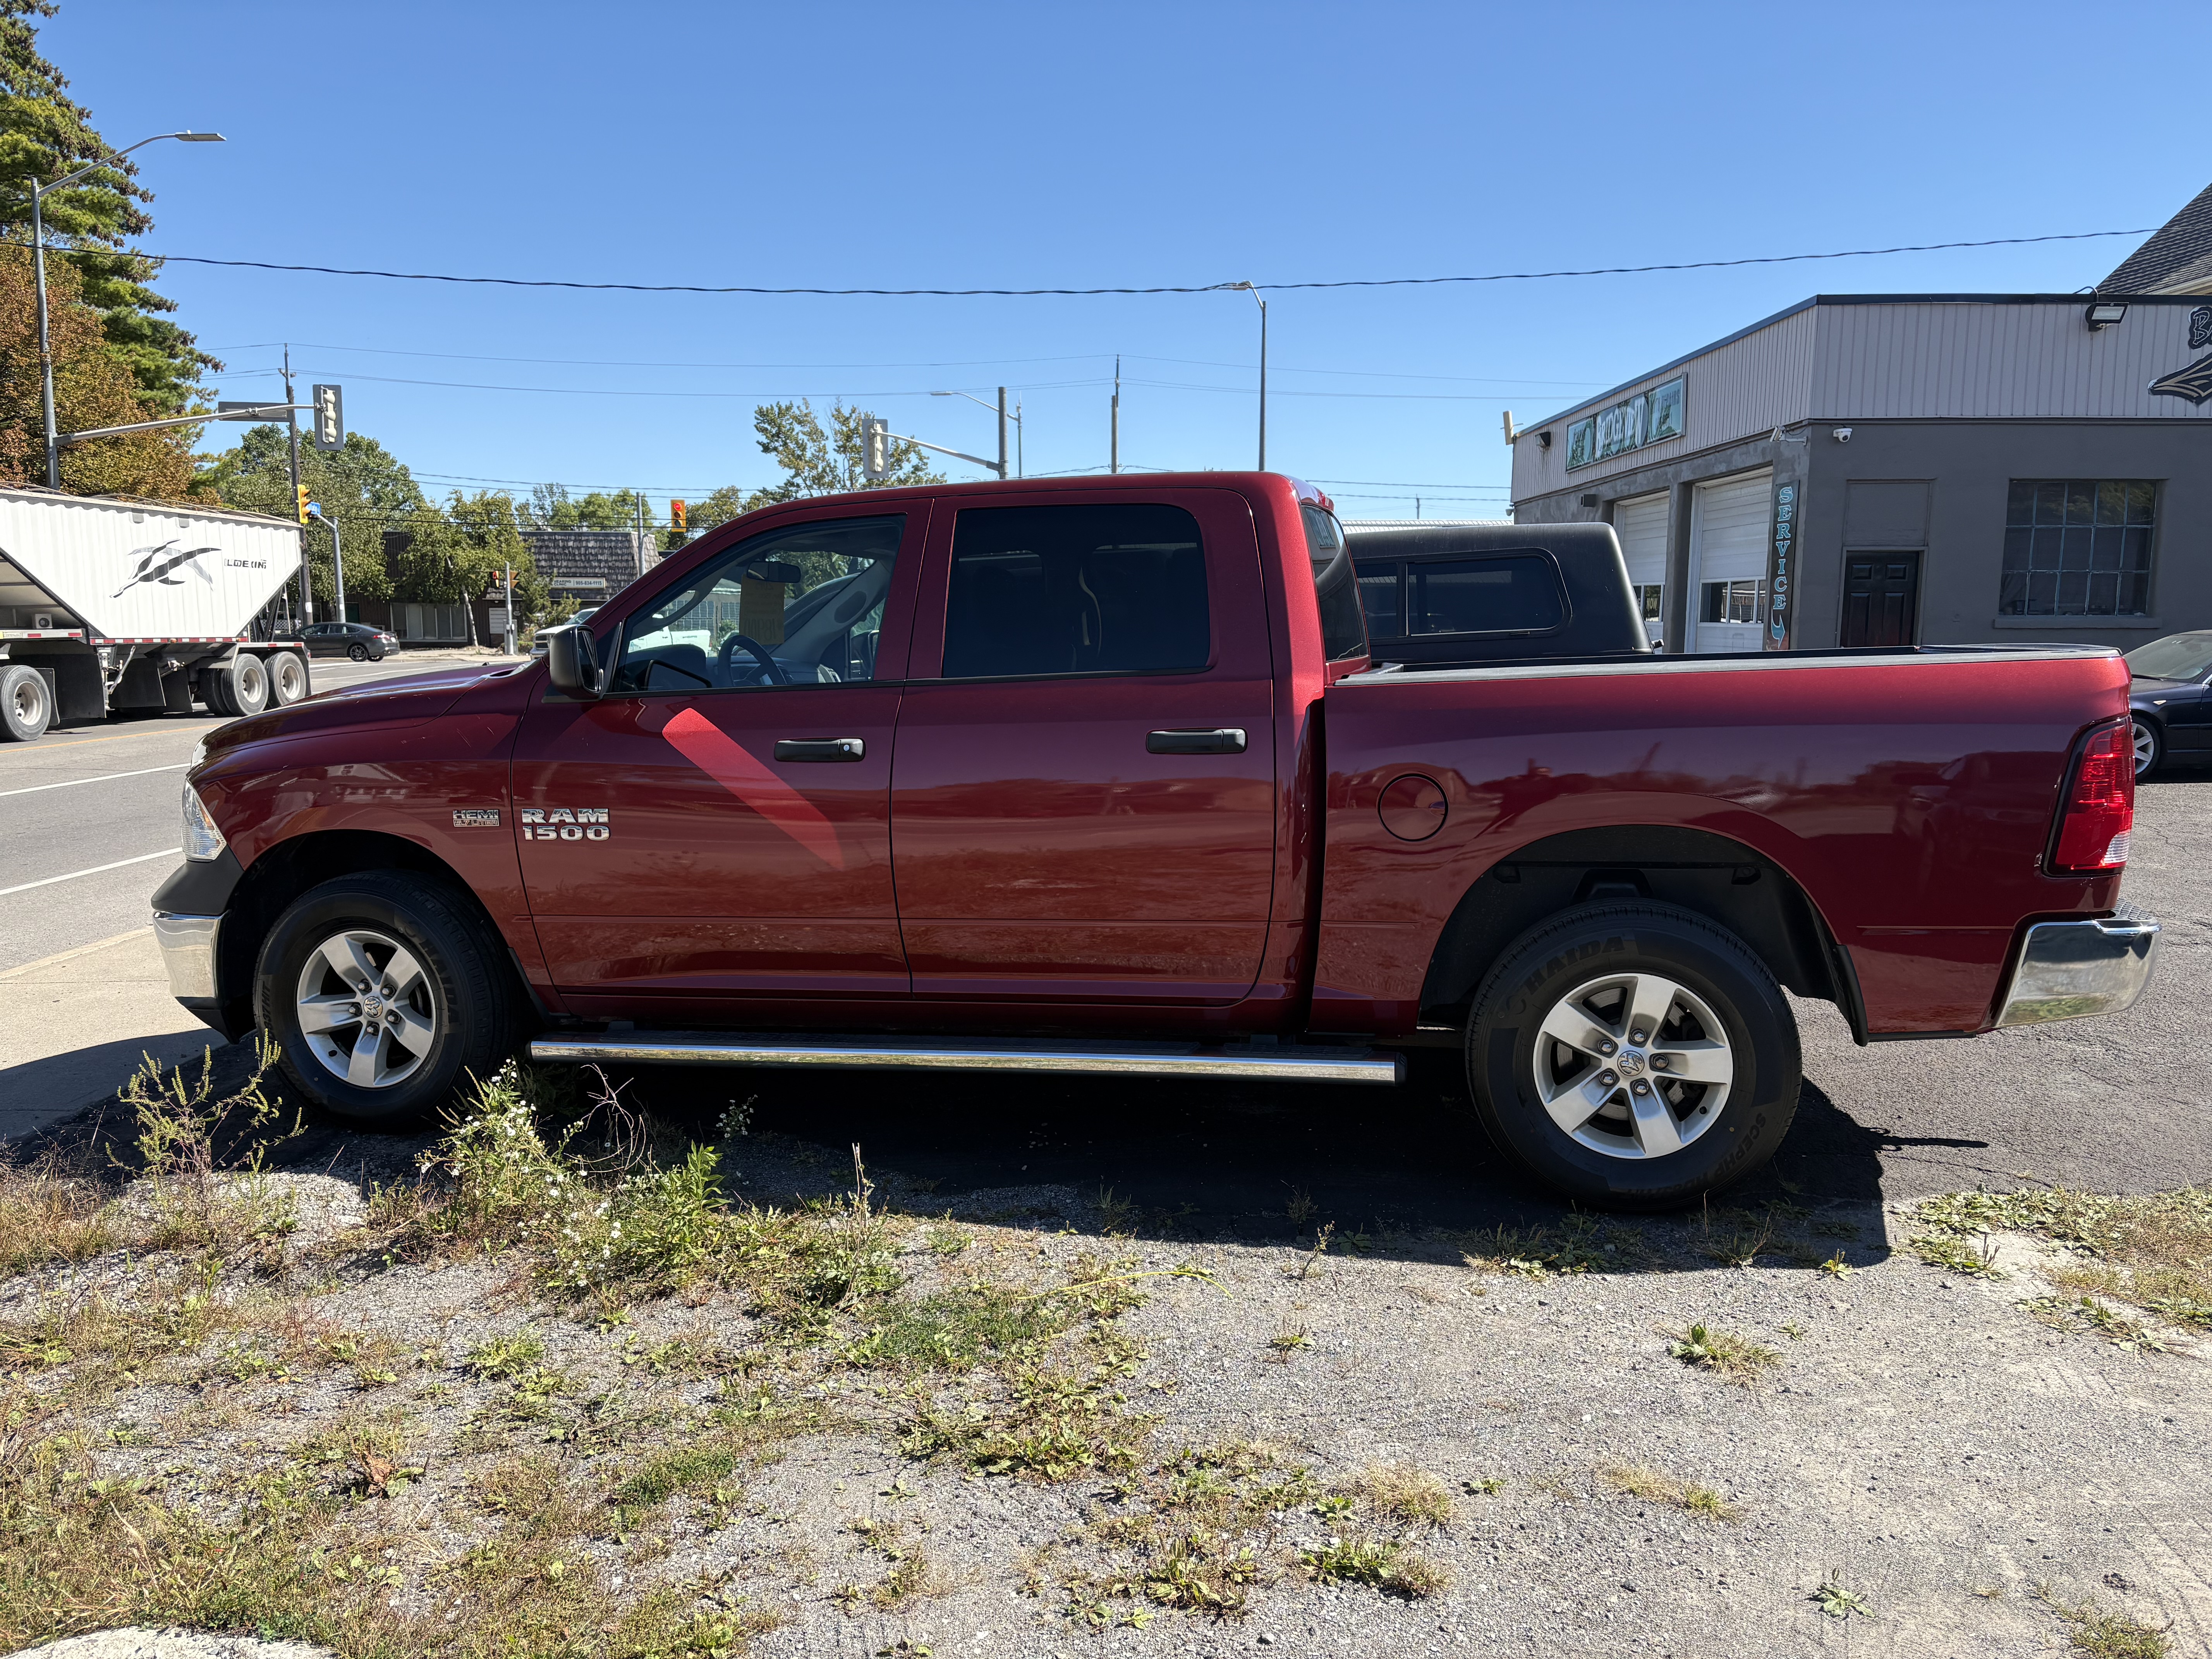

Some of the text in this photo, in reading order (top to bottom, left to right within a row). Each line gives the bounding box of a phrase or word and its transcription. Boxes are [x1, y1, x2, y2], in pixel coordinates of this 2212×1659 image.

[2193, 310, 2212, 345] B
[1773, 486, 1793, 610] SERVICE
[453, 809, 498, 819] HEMI
[522, 808, 609, 823] RAM
[522, 825, 610, 841] 1500
